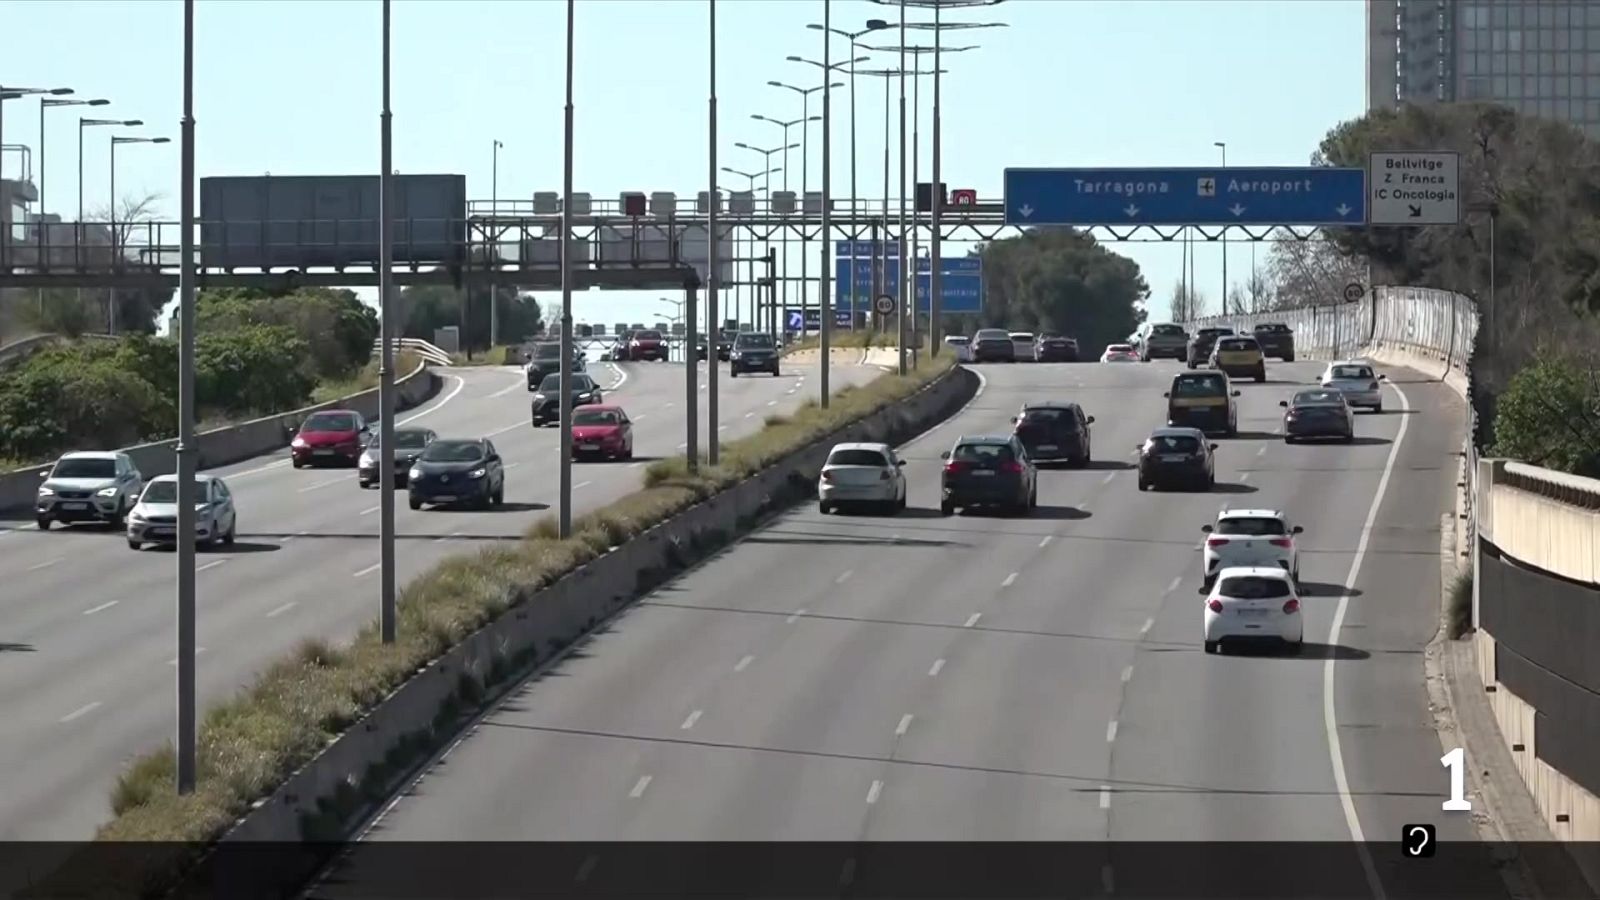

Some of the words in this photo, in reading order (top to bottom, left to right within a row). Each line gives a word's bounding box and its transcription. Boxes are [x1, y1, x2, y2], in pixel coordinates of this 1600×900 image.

[1385, 157, 1443, 171] Bellvitge
[1384, 173, 1392, 183] Z
[1402, 173, 1444, 184] Franca
[1074, 179, 1169, 197] Tarragona
[1227, 178, 1311, 195] Aeroport
[1375, 188, 1387, 200] IC
[1393, 188, 1455, 202] Oncologia
